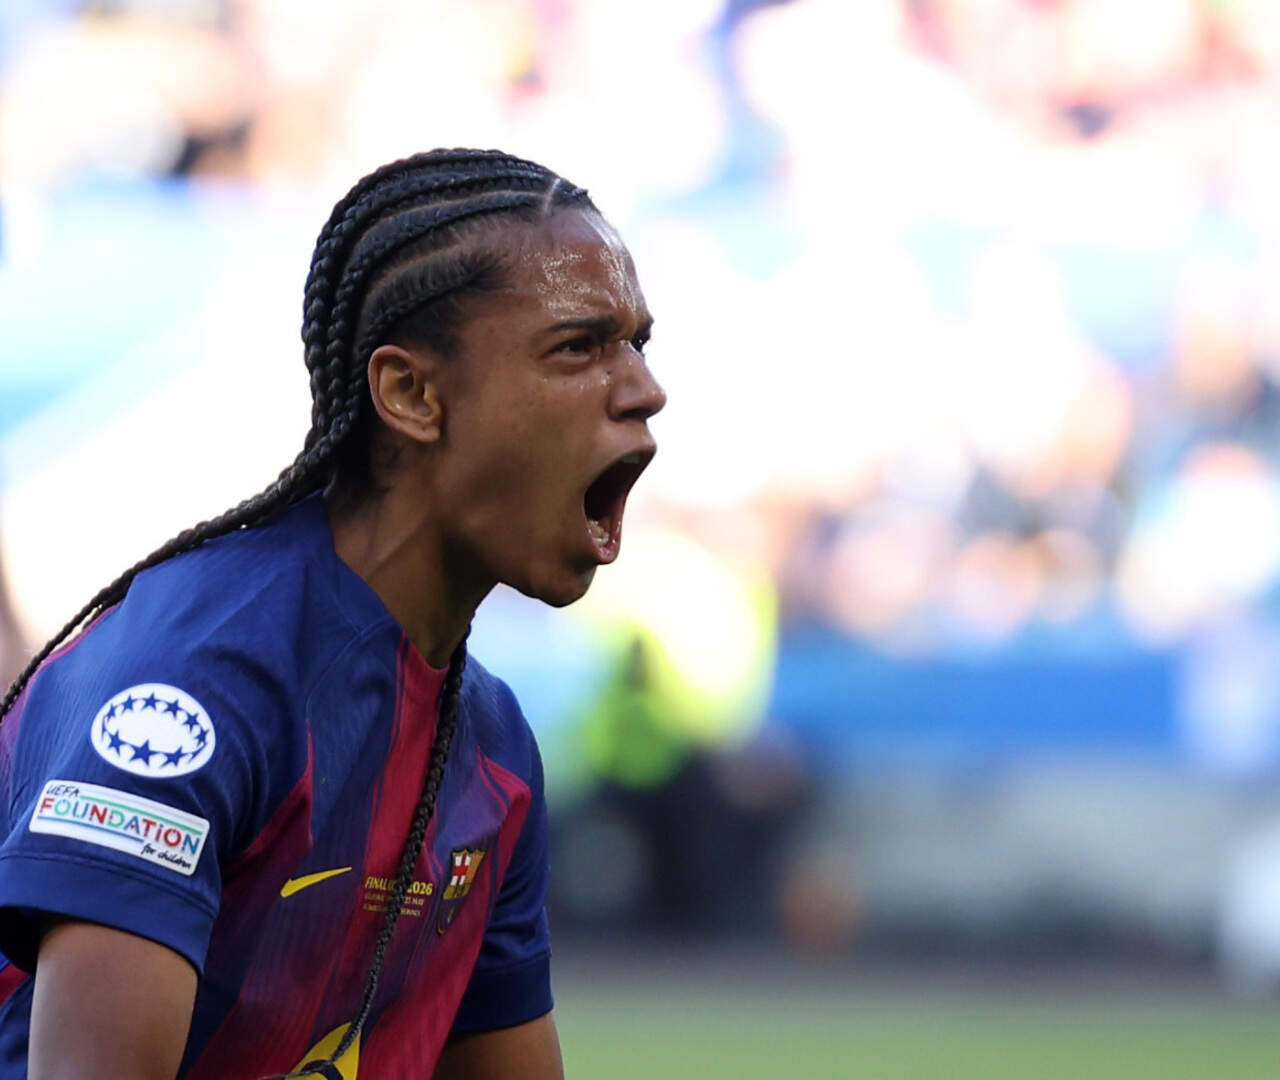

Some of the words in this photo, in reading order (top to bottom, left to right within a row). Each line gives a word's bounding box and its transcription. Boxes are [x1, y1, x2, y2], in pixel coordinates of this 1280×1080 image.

[46, 784, 80, 797] UEFA
[141, 843, 157, 856] for
[158, 849, 192, 870] children
